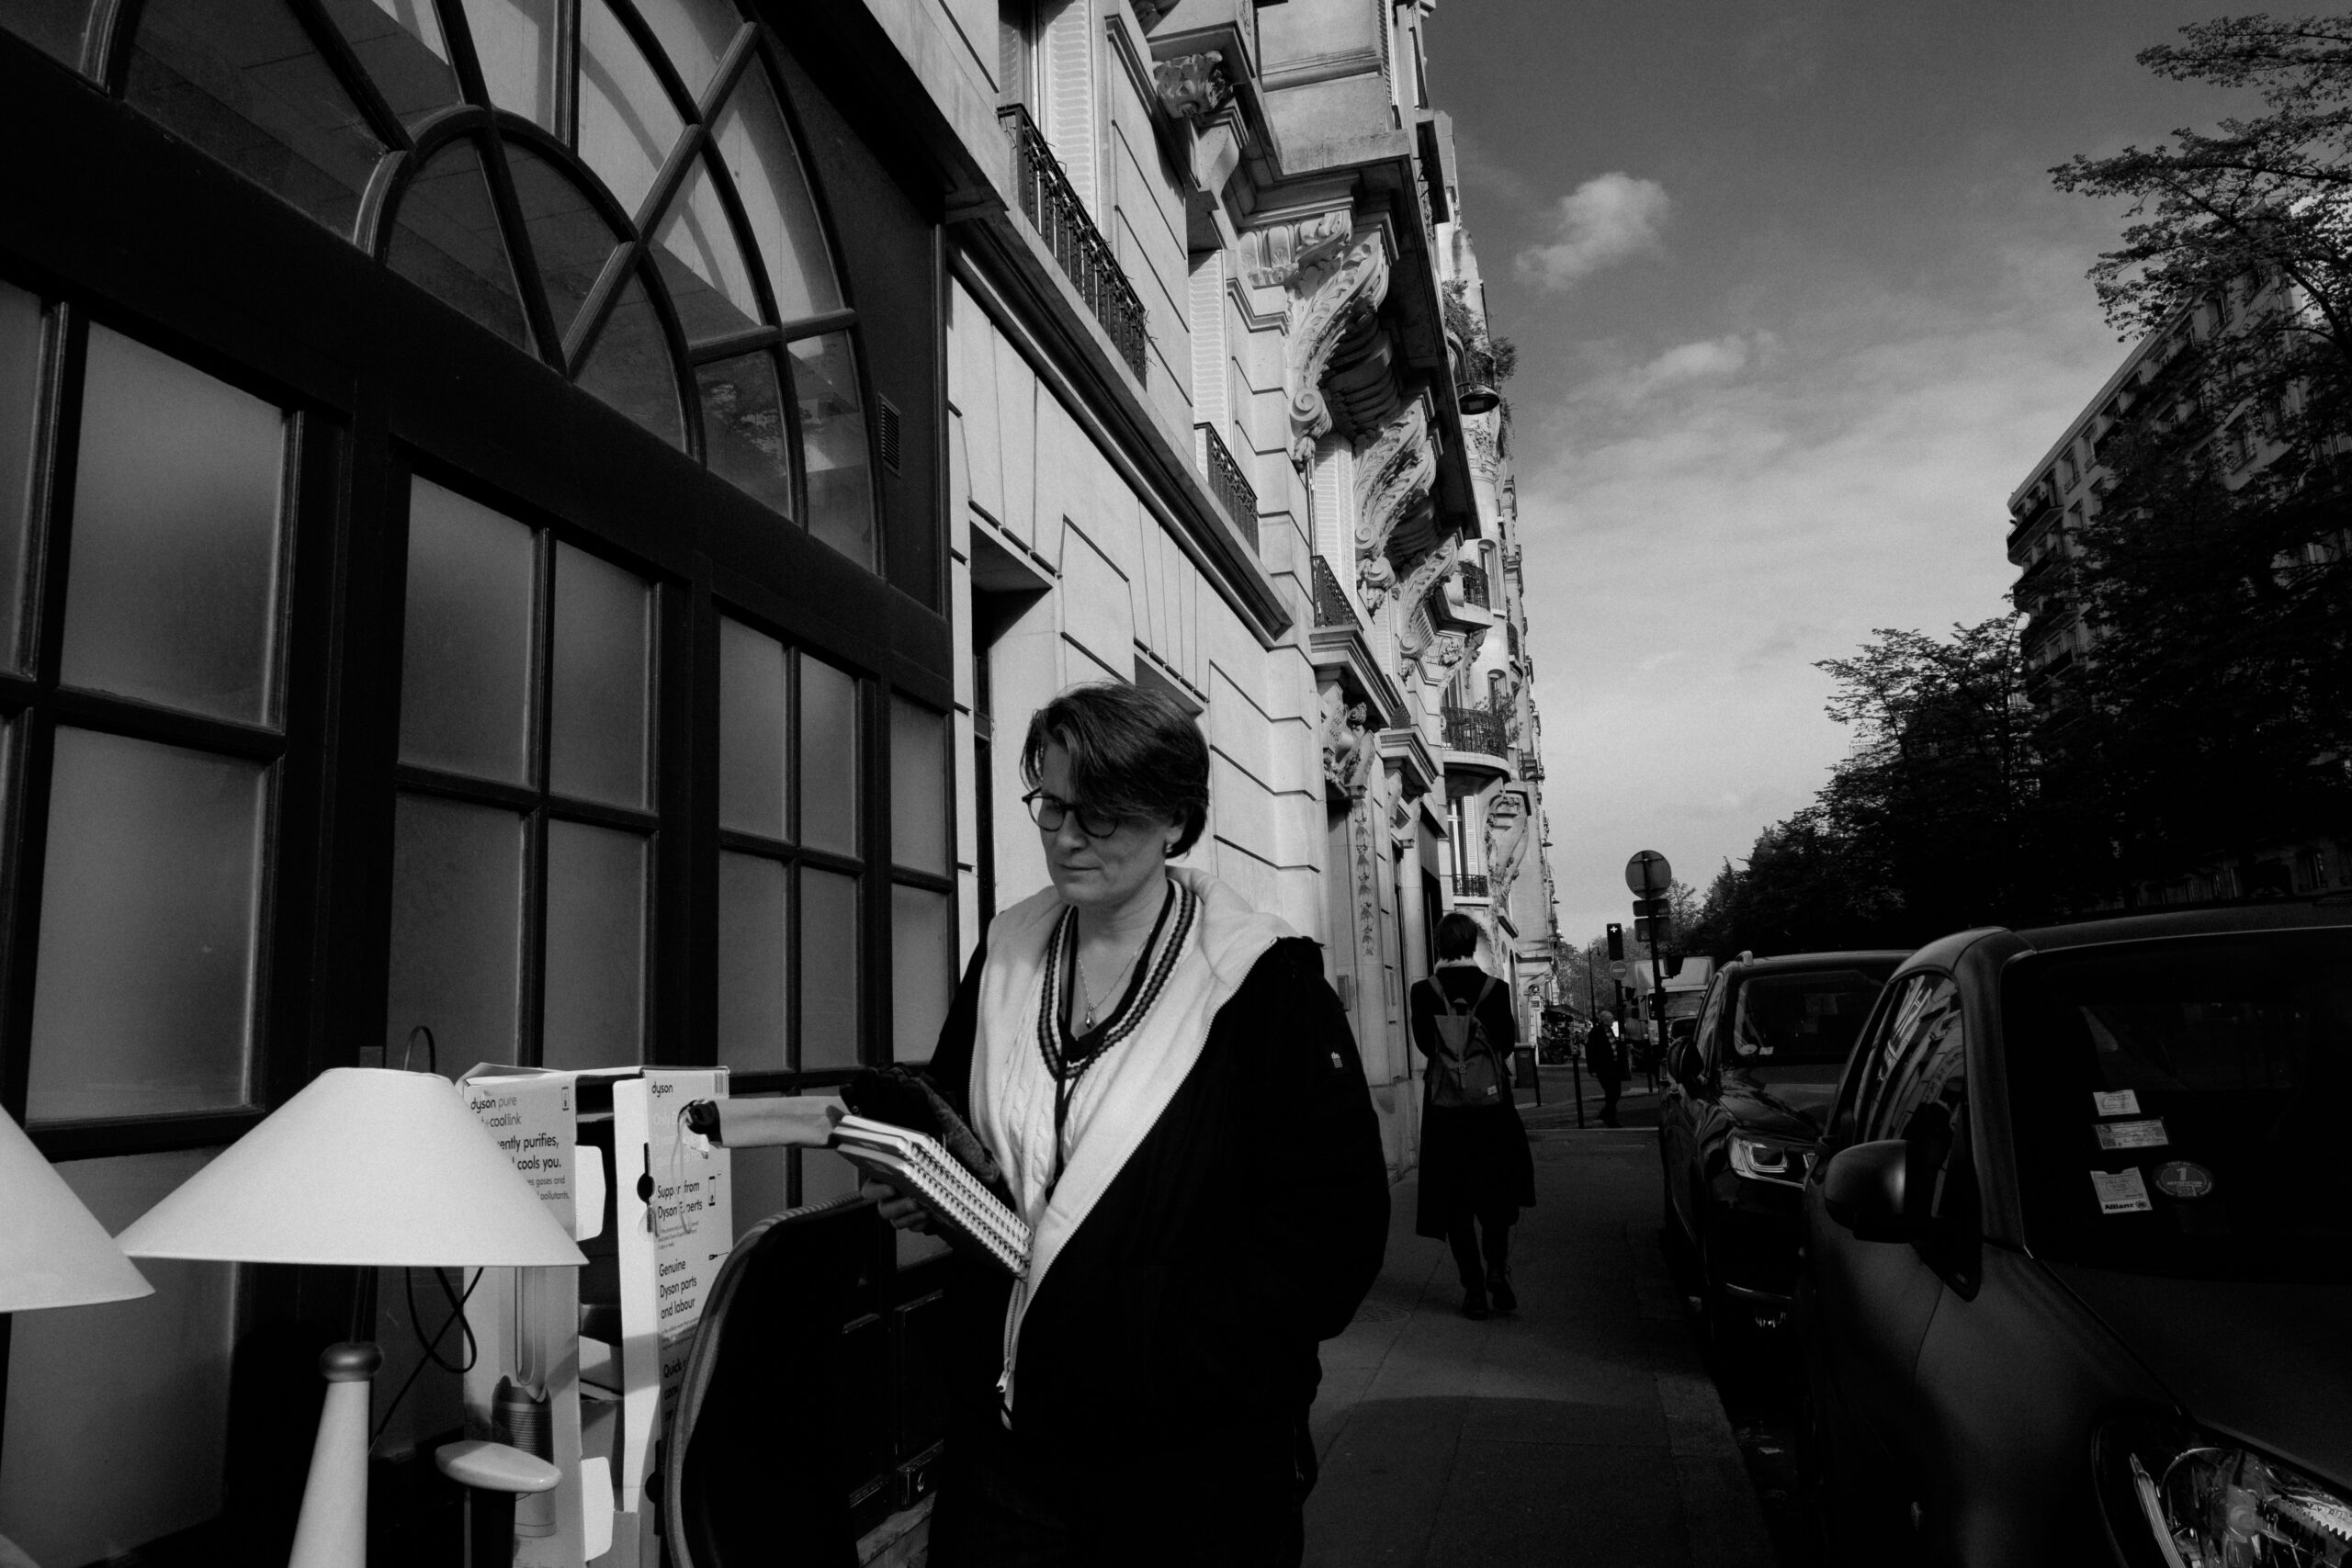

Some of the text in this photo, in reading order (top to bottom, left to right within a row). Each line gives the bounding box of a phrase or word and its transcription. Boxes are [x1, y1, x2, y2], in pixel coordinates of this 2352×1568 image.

[652, 1081, 673, 1098] dyson
[470, 1097, 517, 1113] dyson pure
[497, 1133, 560, 1153] ently purifies,
[517, 1155, 562, 1172] cools you.
[536, 1178, 553, 1188] gases
[554, 1175, 566, 1185] and
[2176, 1168, 2187, 1181] 1
[684, 1179, 700, 1193] from
[658, 1199, 703, 1222] Dyson Eperts
[660, 1258, 686, 1277] Genuine
[661, 1276, 697, 1300] Dyson parts
[662, 1299, 695, 1319] and labour
